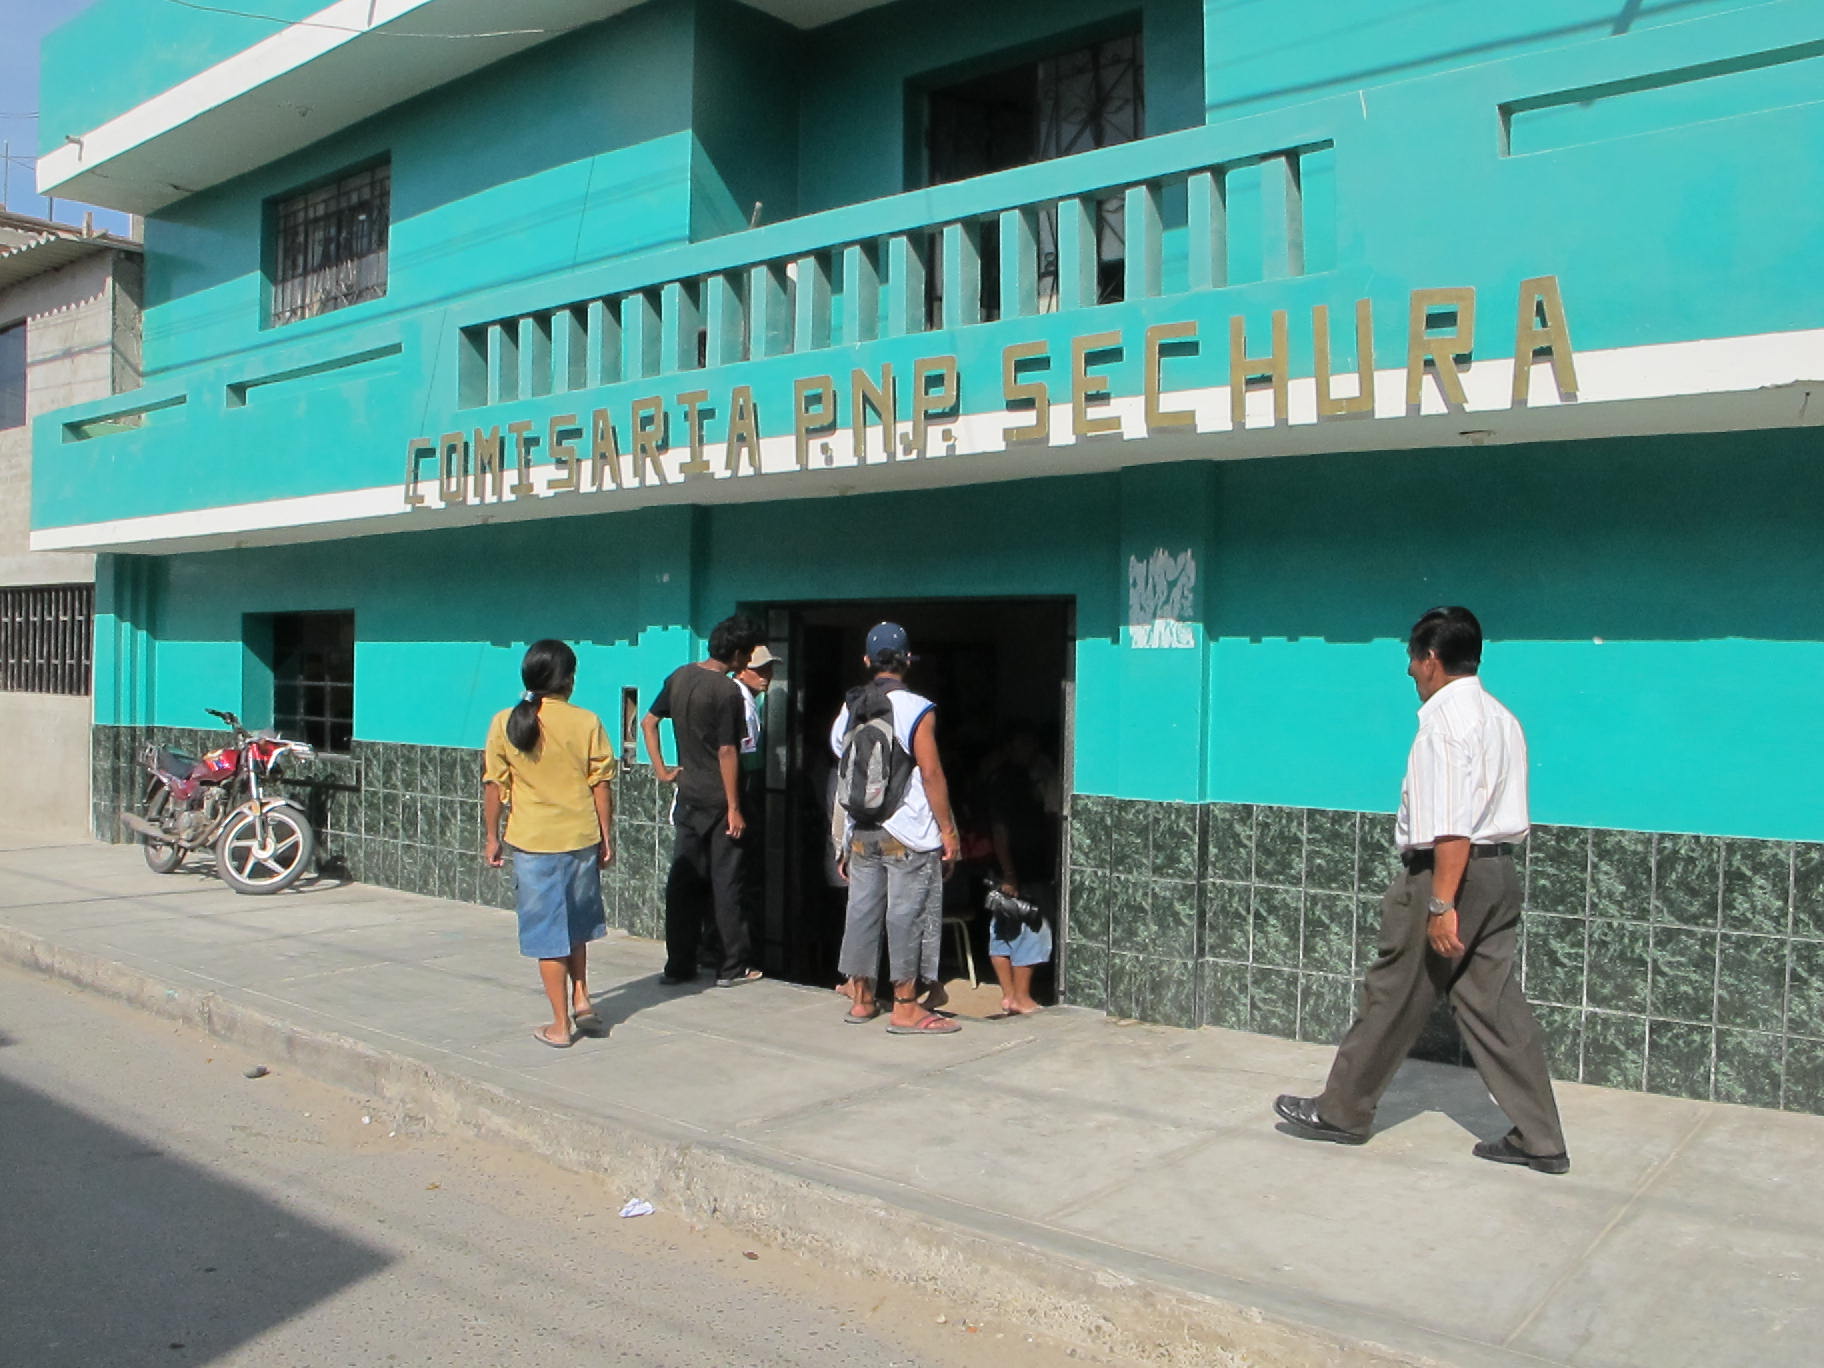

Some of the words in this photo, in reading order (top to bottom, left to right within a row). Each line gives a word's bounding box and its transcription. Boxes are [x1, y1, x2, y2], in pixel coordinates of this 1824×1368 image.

[404, 386, 759, 504] COMISARIA
[794, 355, 957, 466] P.N.P.
[1003, 275, 1578, 440] SECHURA
